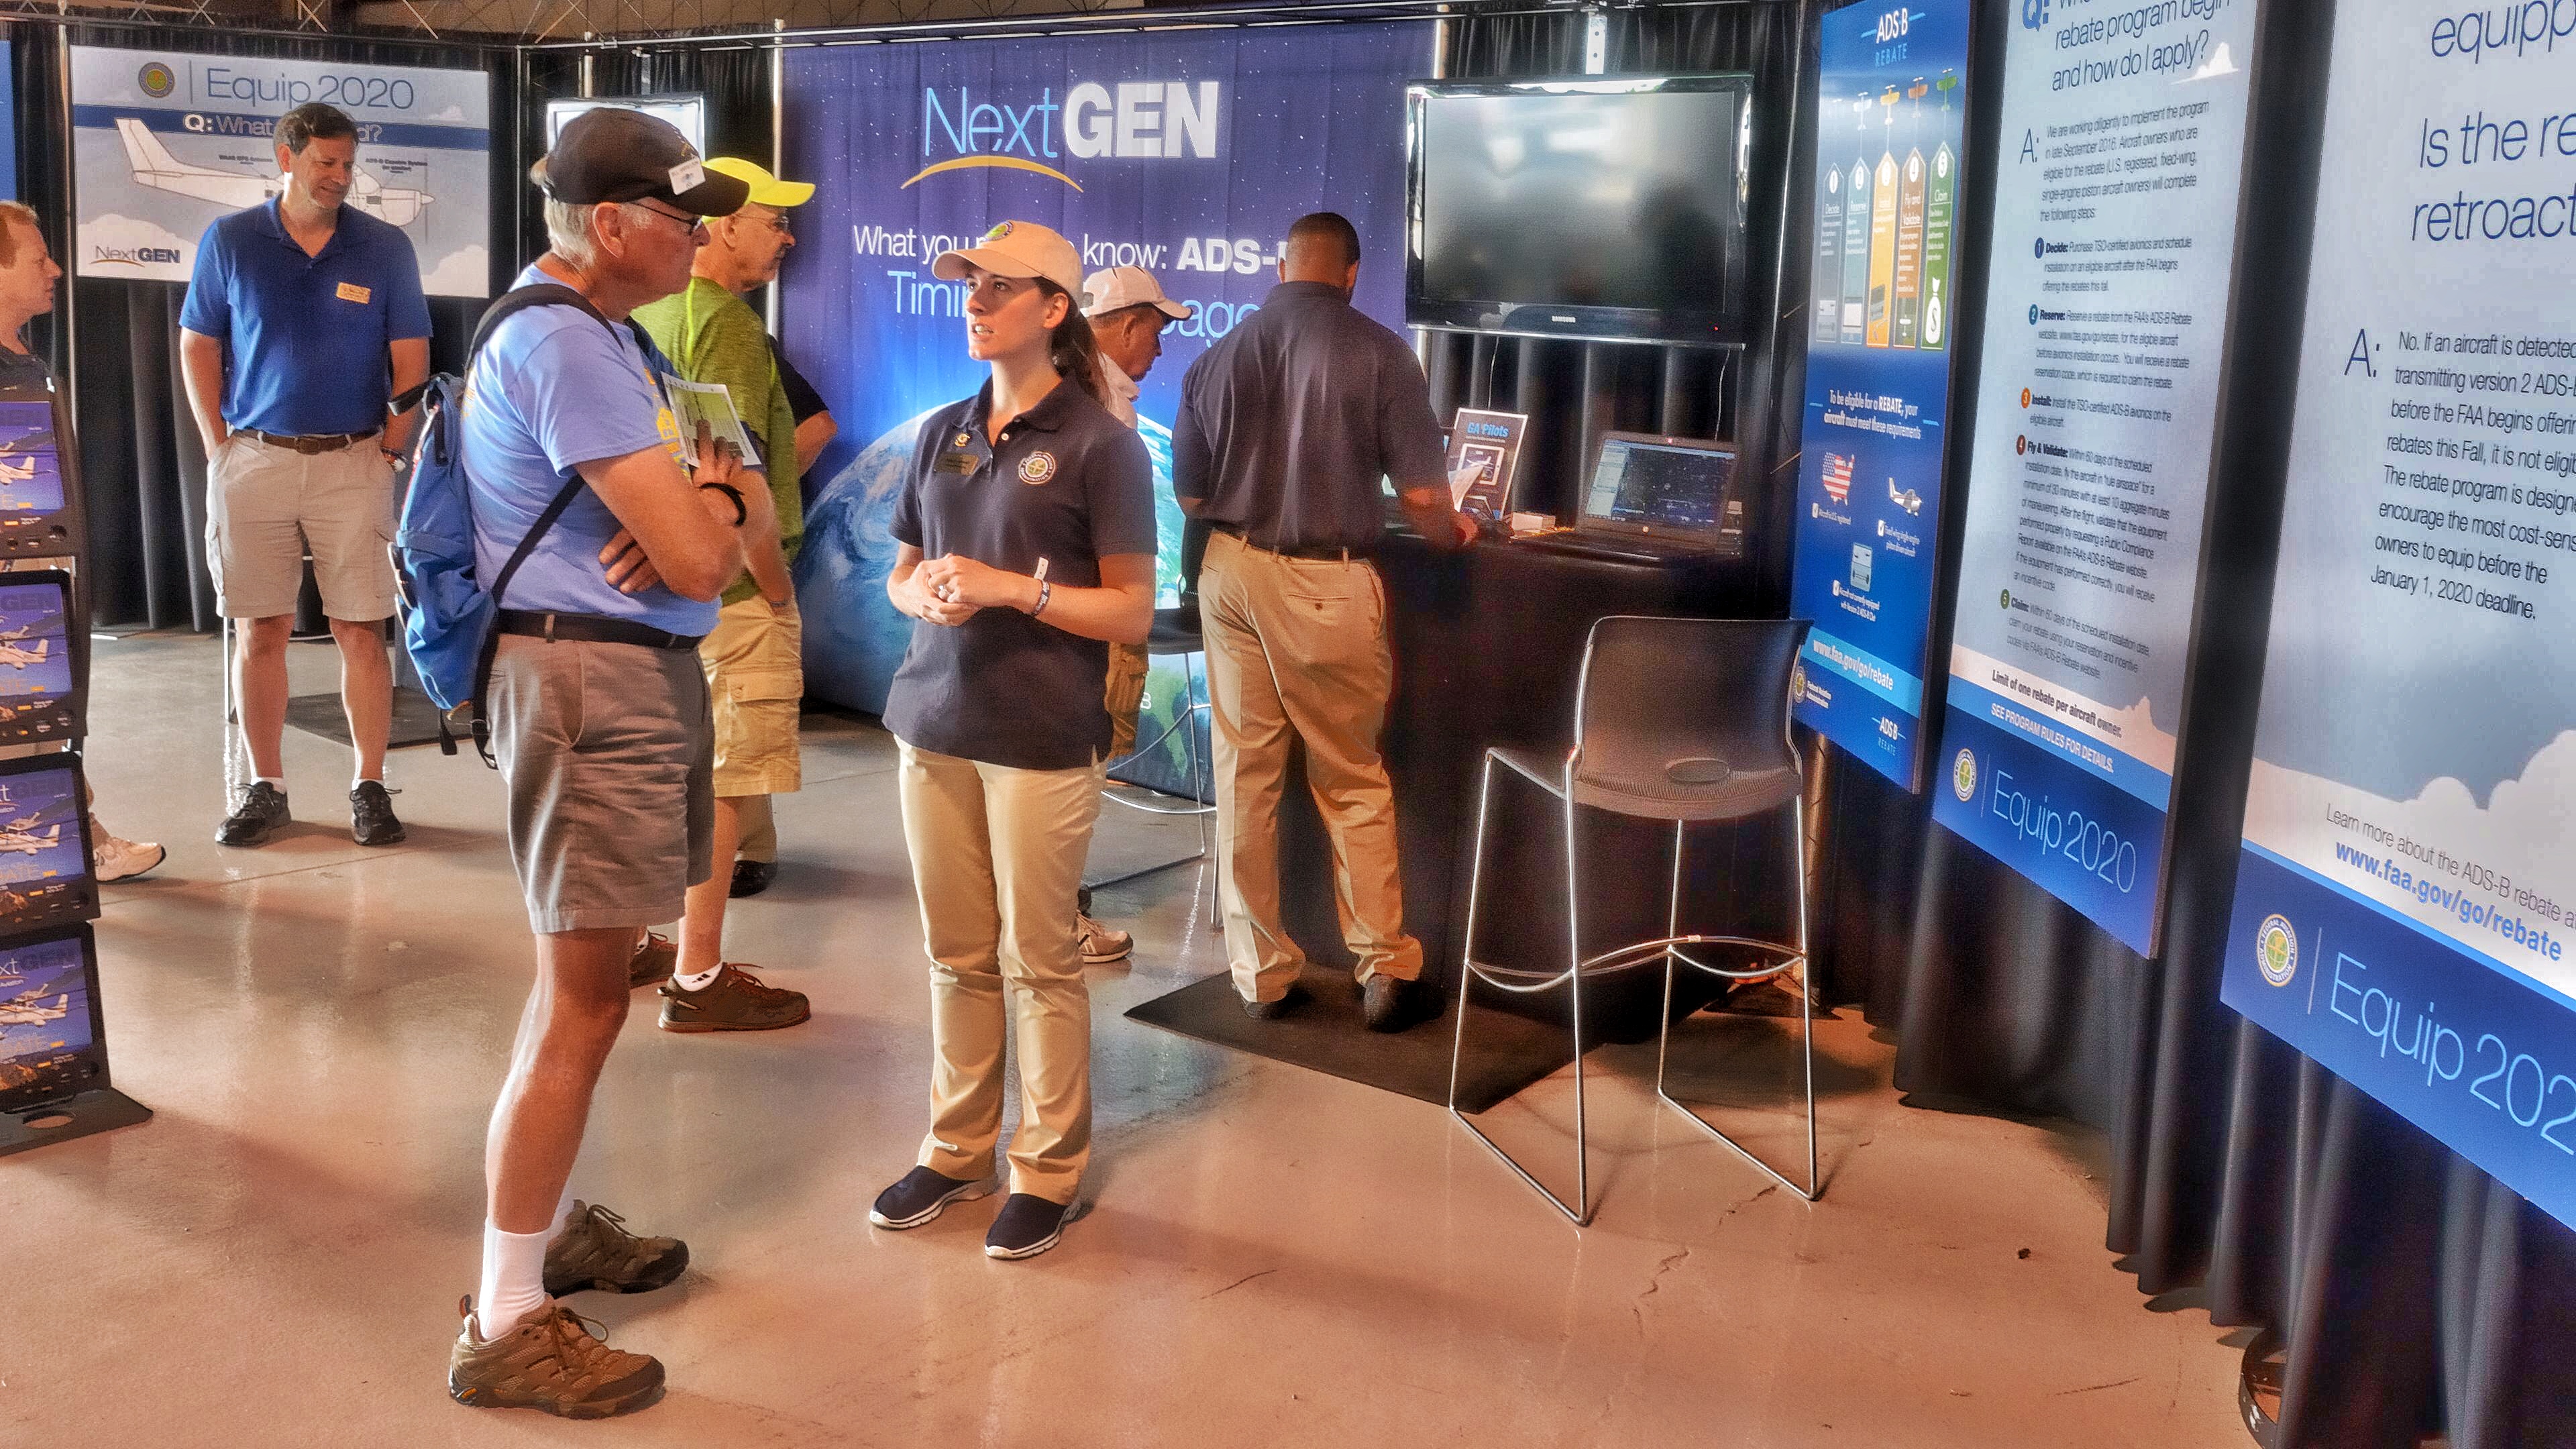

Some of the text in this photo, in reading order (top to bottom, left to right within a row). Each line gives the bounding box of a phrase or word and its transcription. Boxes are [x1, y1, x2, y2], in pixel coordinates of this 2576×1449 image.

[2055, 17, 2103, 49] rebate
[2106, 0, 2176, 44] program
[1876, 43, 1907, 66] REBATE
[2052, 29, 2208, 91] and how do I apply?
[207, 68, 311, 109] Equip
[318, 75, 414, 110] 2020
[183, 113, 273, 135] Q: What
[925, 81, 1220, 158] NextGEN
[2047, 101, 2209, 138] We are working diligently to implement the program
[2019, 128, 2039, 164] A:
[2045, 149, 2051, 159] in
[2051, 147, 2063, 158] late
[2063, 143, 2097, 157] September
[2119, 133, 2141, 148] Aircraft
[2143, 131, 2167, 146] owners
[2169, 129, 2185, 142] who
[2186, 127, 2198, 140] are
[2420, 118, 2449, 168] Is
[2460, 111, 2528, 163] the
[2043, 168, 2063, 182] eligible
[2065, 167, 2073, 177] for
[2074, 166, 2084, 176] the
[2085, 163, 2105, 175] rebate
[95, 245, 180, 264] NextGEN
[853, 225, 916, 257] What
[1083, 233, 1167, 269] know:
[2045, 242, 2068, 253] Decide:
[1552, 315, 1576, 323] SAMSUNG
[2039, 309, 2065, 321] Reserve:
[2344, 328, 2379, 377] A:
[2399, 331, 2419, 350] No.
[2424, 332, 2432, 351] If
[2434, 337, 2450, 352] an
[2453, 334, 2497, 354] aircraft
[2501, 335, 2512, 355] is
[2396, 367, 2465, 393] transmitting
[2469, 374, 2516, 392] version
[2520, 373, 2530, 393] 2
[1829, 389, 1836, 404] To
[1836, 390, 1843, 405] be
[1844, 390, 1864, 411] eligible
[1864, 392, 1873, 409] for
[1878, 396, 1903, 416] REBATE,
[2391, 399, 2430, 420] before
[2434, 402, 2453, 423] the
[2457, 404, 2483, 425] FAA
[2487, 407, 2532, 433] begins
[1467, 422, 1509, 438] GA Pilots
[1823, 409, 1845, 425] aircraft
[1871, 415, 1886, 433] these
[1886, 421, 1921, 439] requirements
[2027, 441, 2068, 458] Fly & Validate:
[2387, 433, 2432, 455] rebates
[2436, 439, 2458, 458] this
[2462, 440, 2485, 464] Fall,
[2491, 443, 2499, 464] it
[2503, 445, 2514, 466] is
[2518, 450, 2540, 469] not
[2383, 464, 2406, 486] The
[2409, 472, 2449, 492] rebate
[2452, 480, 2507, 502] program
[2511, 484, 2522, 504] is
[2379, 502, 2444, 530] encourage
[2448, 511, 2468, 531] the
[2471, 519, 2506, 538] most
[2375, 535, 2547, 584] owners to equip before the
[2371, 565, 2536, 621] January 1, 2020 deadline.
[1813, 640, 1893, 690] www.faa.gov/go/rebate
[1992, 669, 2009, 687] Limit
[2009, 678, 2018, 690] of
[2018, 683, 2031, 696] one
[2032, 689, 2054, 706] rebate
[2055, 699, 2068, 712] per
[2069, 704, 2096, 726] aircraft
[1991, 703, 2113, 773] SEE PROGRAM RULES FOR DETAILS.
[1993, 769, 2061, 855] Equip
[2063, 811, 2136, 893] 2020
[2326, 803, 2359, 829] Learn
[2363, 822, 2394, 847] more
[2397, 837, 2434, 865] about
[2438, 851, 2458, 875] the
[2462, 861, 2510, 898] ADS-B
[2514, 888, 2560, 921] rebate
[2337, 843, 2561, 960] www.faa.gov/go/rebate
[2330, 952, 2463, 1086] Equip
